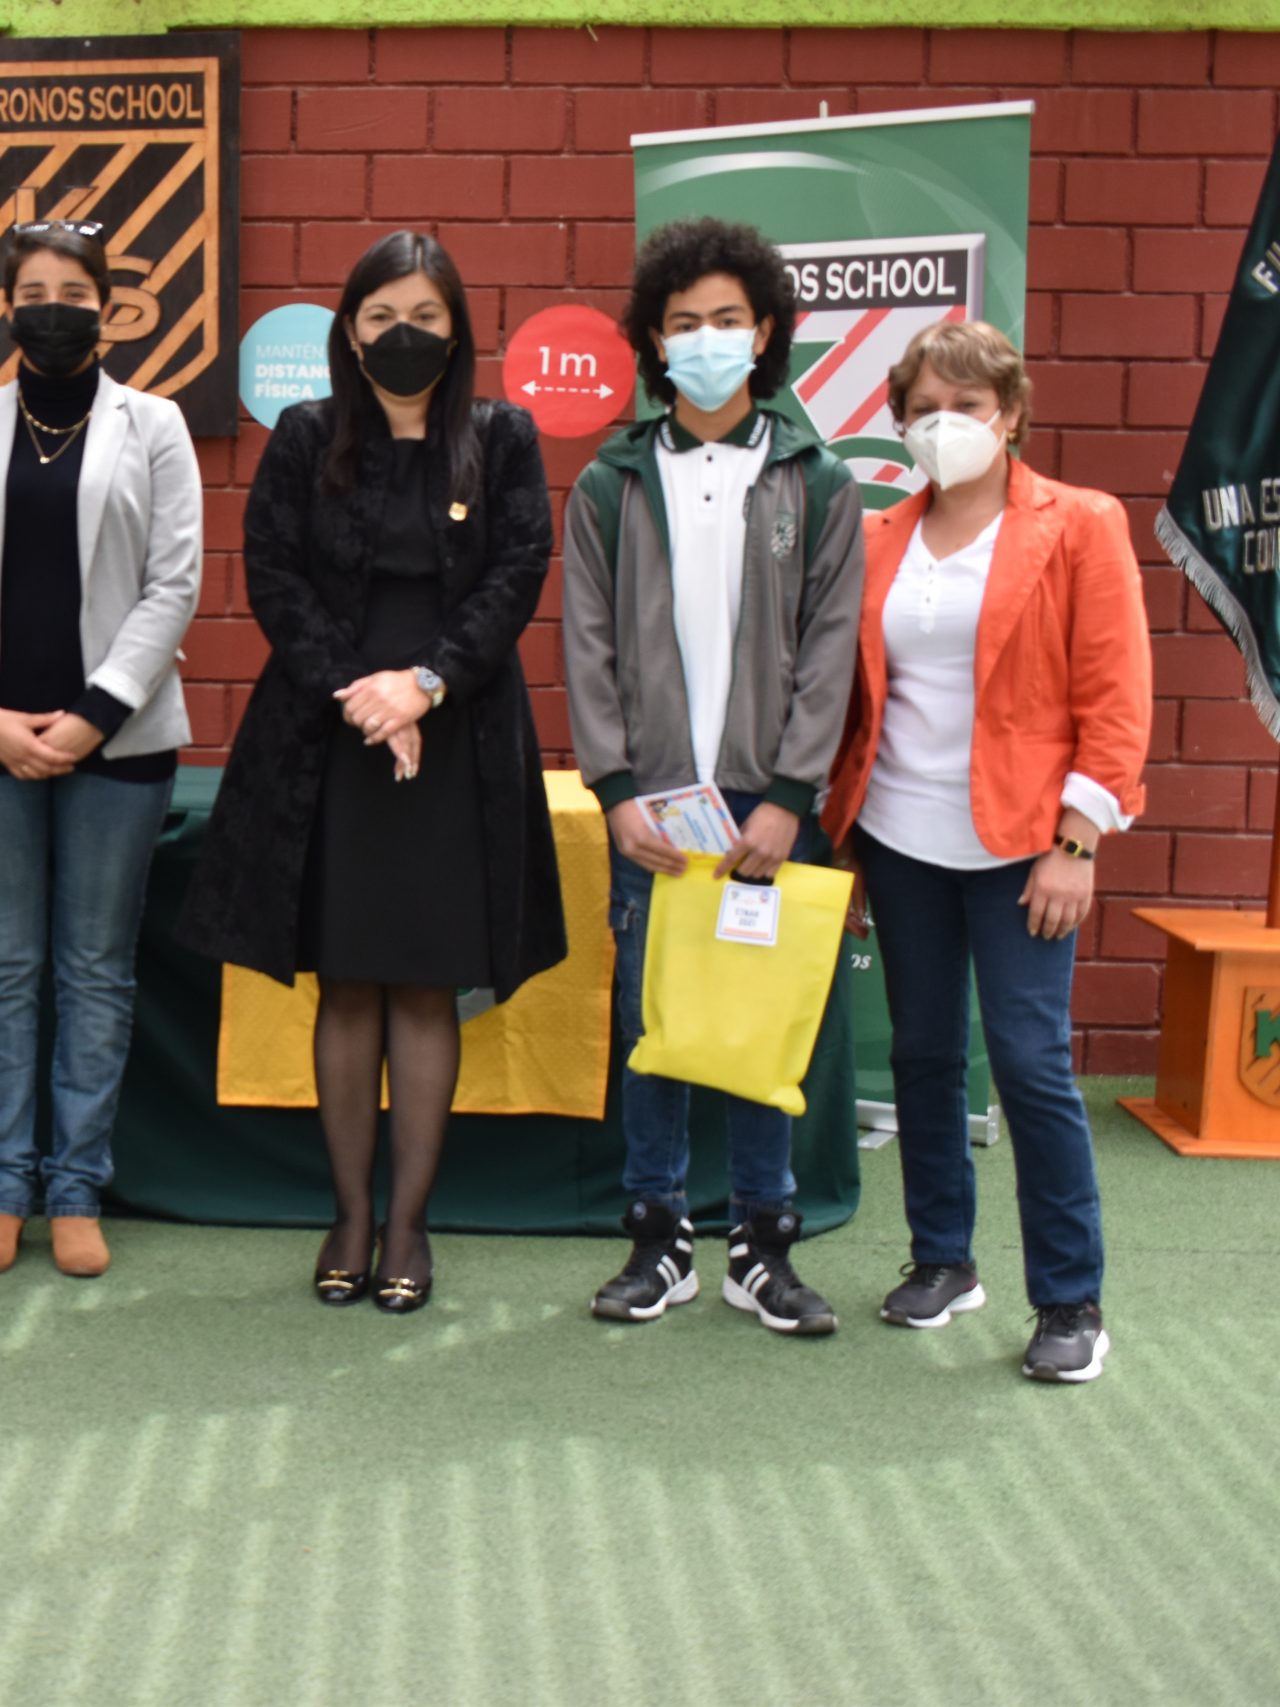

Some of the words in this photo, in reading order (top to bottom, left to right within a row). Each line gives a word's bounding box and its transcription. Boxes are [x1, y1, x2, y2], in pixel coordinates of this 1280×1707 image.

[88, 83, 202, 121] SCHOOL
[825, 257, 956, 301] SCHOOL
[539, 346, 550, 376] 1
[560, 353, 597, 377] m
[255, 379, 315, 398] FÍSICA
[1202, 483, 1256, 531] UNA
